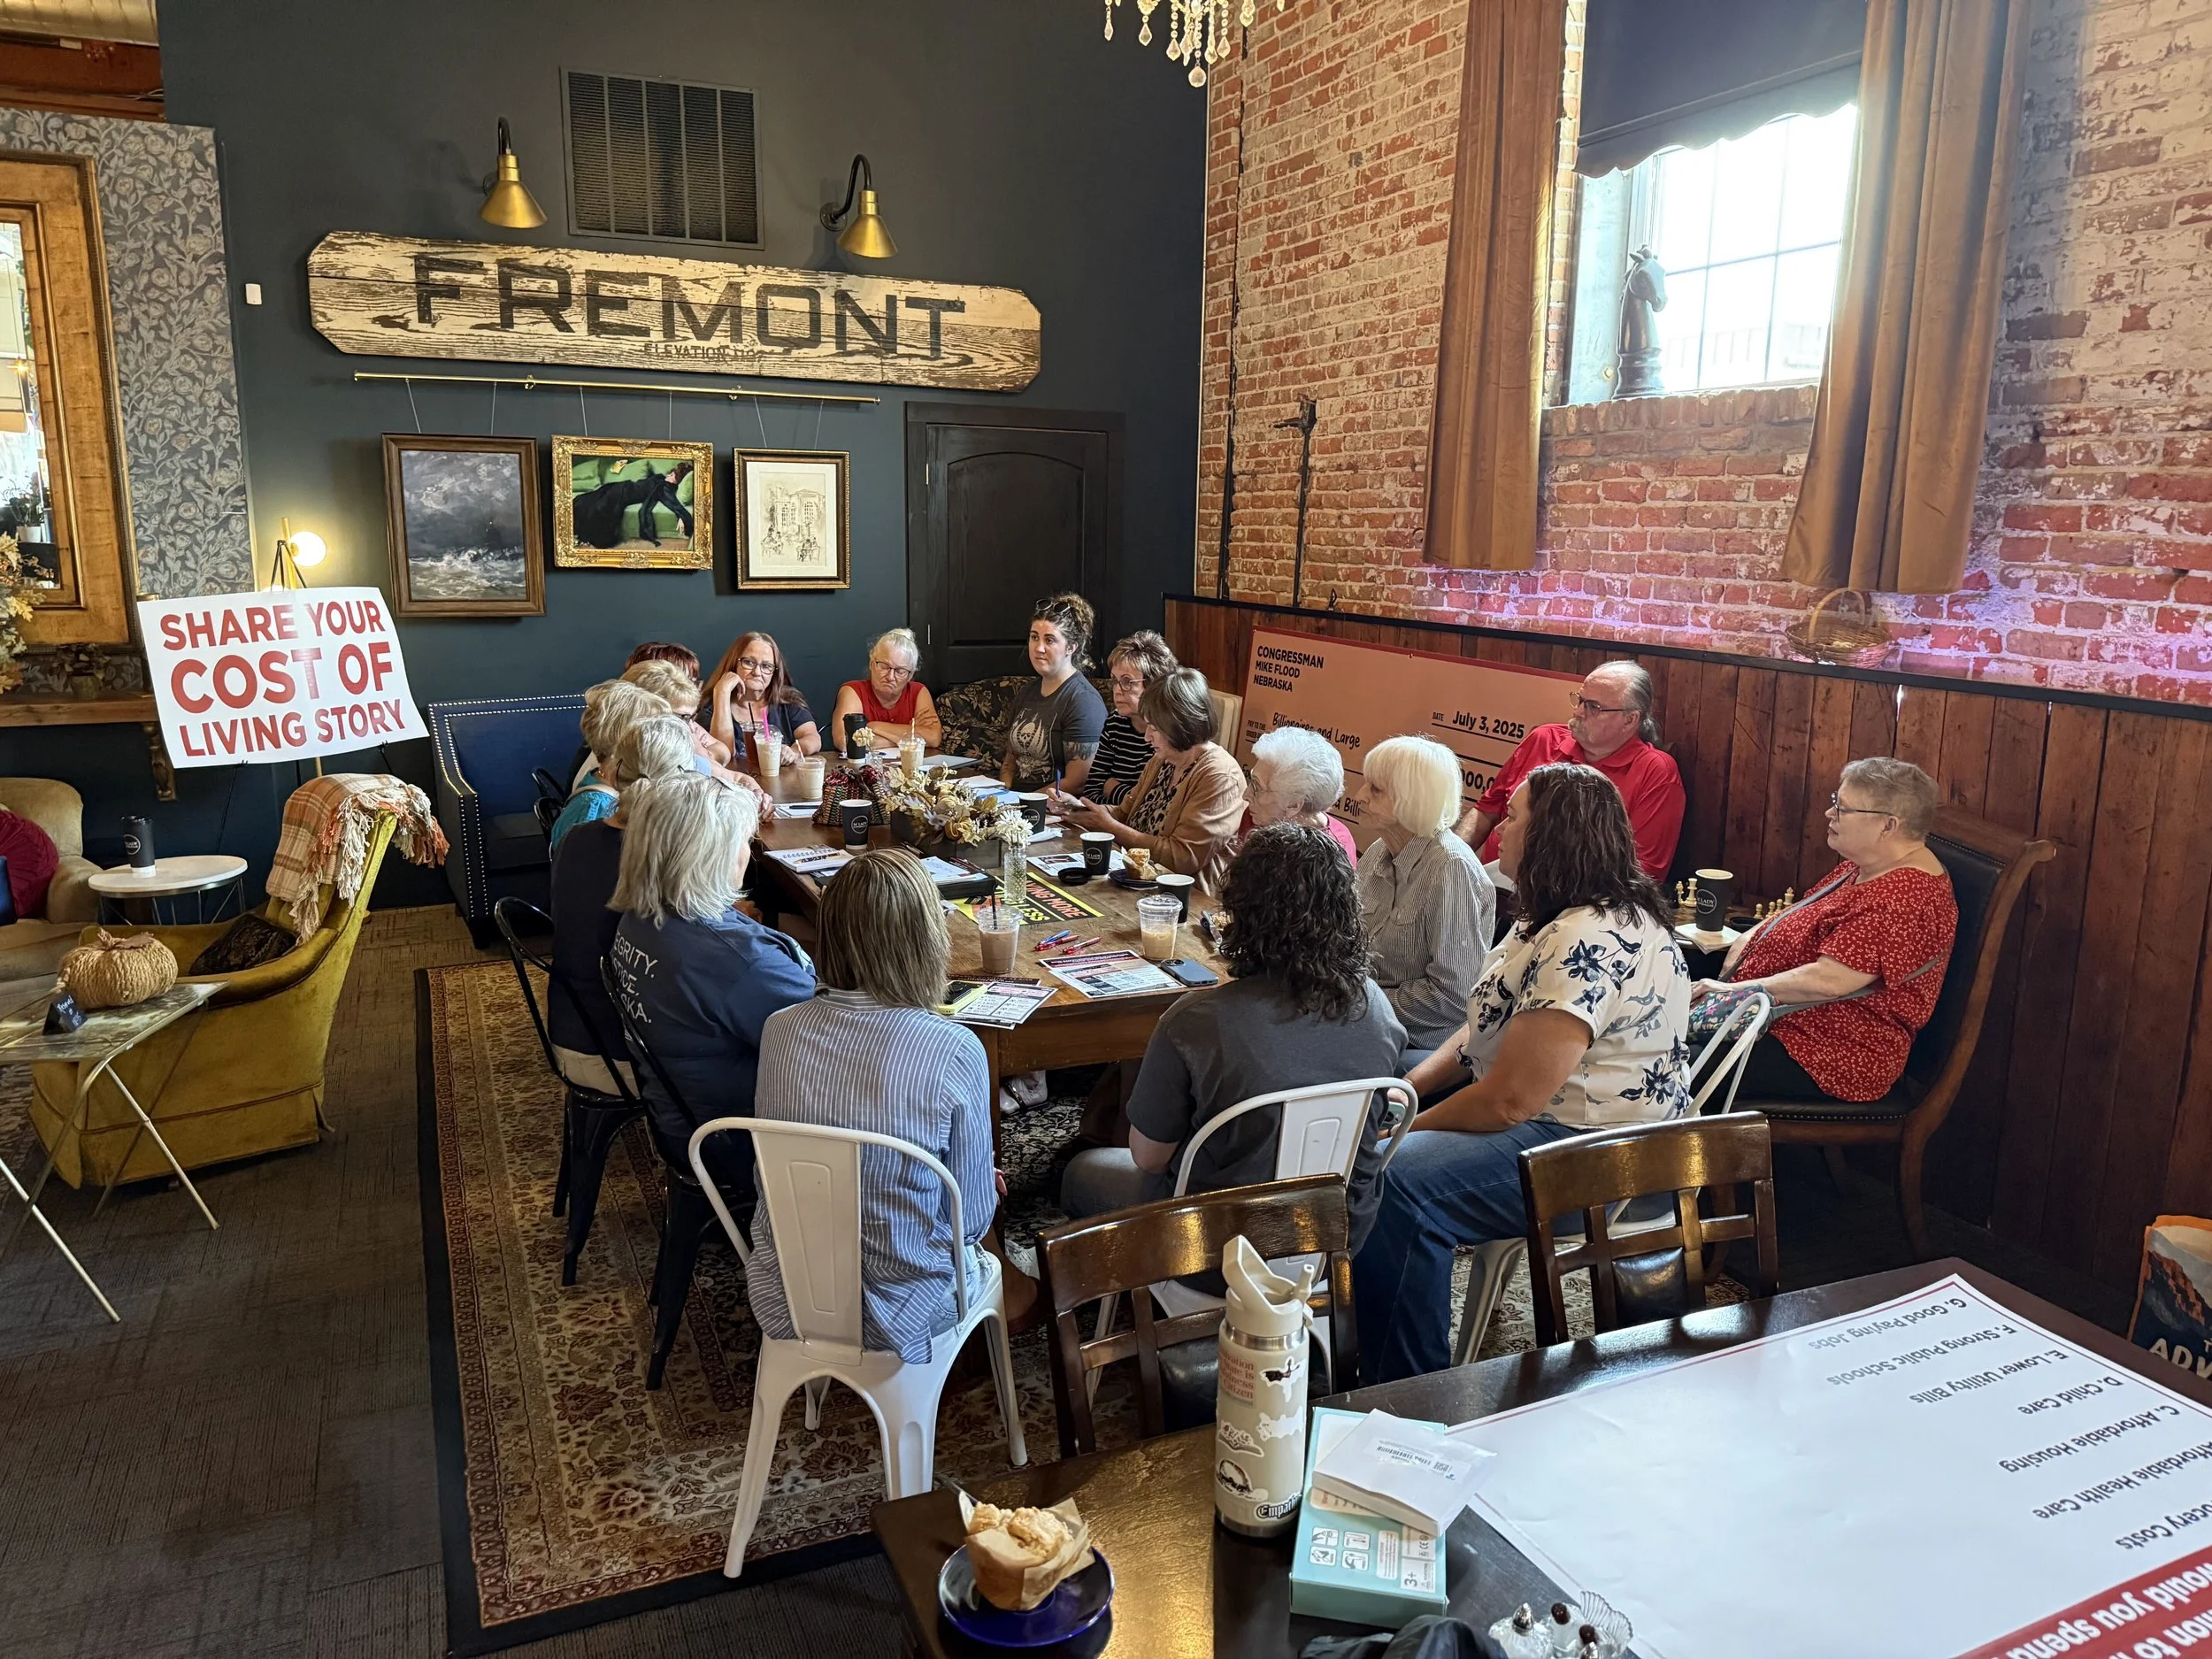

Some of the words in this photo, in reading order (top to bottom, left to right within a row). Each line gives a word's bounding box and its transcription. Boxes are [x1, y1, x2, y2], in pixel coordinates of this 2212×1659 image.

[414, 254, 966, 358] FREMONT
[160, 604, 299, 650] SHARE
[305, 601, 386, 636] YOUR
[1257, 646, 1324, 669] CONGRESSMAN
[171, 647, 322, 714] COST
[338, 641, 393, 695] OF
[1256, 660, 1272, 672] MIKE
[1274, 664, 1301, 678] FLOOD
[1253, 674, 1293, 692] NEBRASKA
[180, 711, 307, 757] LIVING
[314, 699, 405, 742] STORY
[1432, 712, 1444, 721] DATE
[1453, 711, 1477, 730] July
[1479, 716, 1489, 733] 3,
[1493, 719, 1525, 739] 2025
[1317, 727, 1333, 741] and
[1335, 729, 1361, 750] Large
[1344, 797, 1362, 817] Billi
[1011, 903, 1050, 922] LESS
[1047, 897, 1088, 918] MORE
[1946, 1297, 1967, 1309] G.
[1902, 1305, 1949, 1325] Good
[1847, 1318, 1909, 1339] Paying
[1995, 1324, 2017, 1335] F.
[1809, 1333, 1850, 1350] Jobs
[1941, 1329, 2001, 1351] Strong
[1892, 1345, 1948, 1365] Public
[1998, 1355, 2053, 1375] Lower
[2045, 1349, 2070, 1360] E.
[2149, 1338, 2212, 1379] ADV
[1826, 1361, 1897, 1386] Schools
[1946, 1371, 2004, 1393] Utility
[2097, 1376, 2124, 1386] D.
[1909, 1386, 1954, 1403] Bills
[2056, 1383, 2105, 1403] Child
[2017, 1397, 2062, 1415] Care
[2154, 1405, 2181, 1416] C.
[2070, 1410, 2162, 1447] Affordable
[1999, 1441, 2079, 1473] Housing
[2074, 1475, 2142, 1504] Health
[2032, 1499, 2082, 1519] Care
[2164, 1501, 2212, 1530] ocery
[2116, 1525, 2173, 1549] Costs
[1404, 1572, 1418, 1587] 3+
[2091, 1591, 2155, 1631] you
[2133, 1636, 2182, 1659] to
